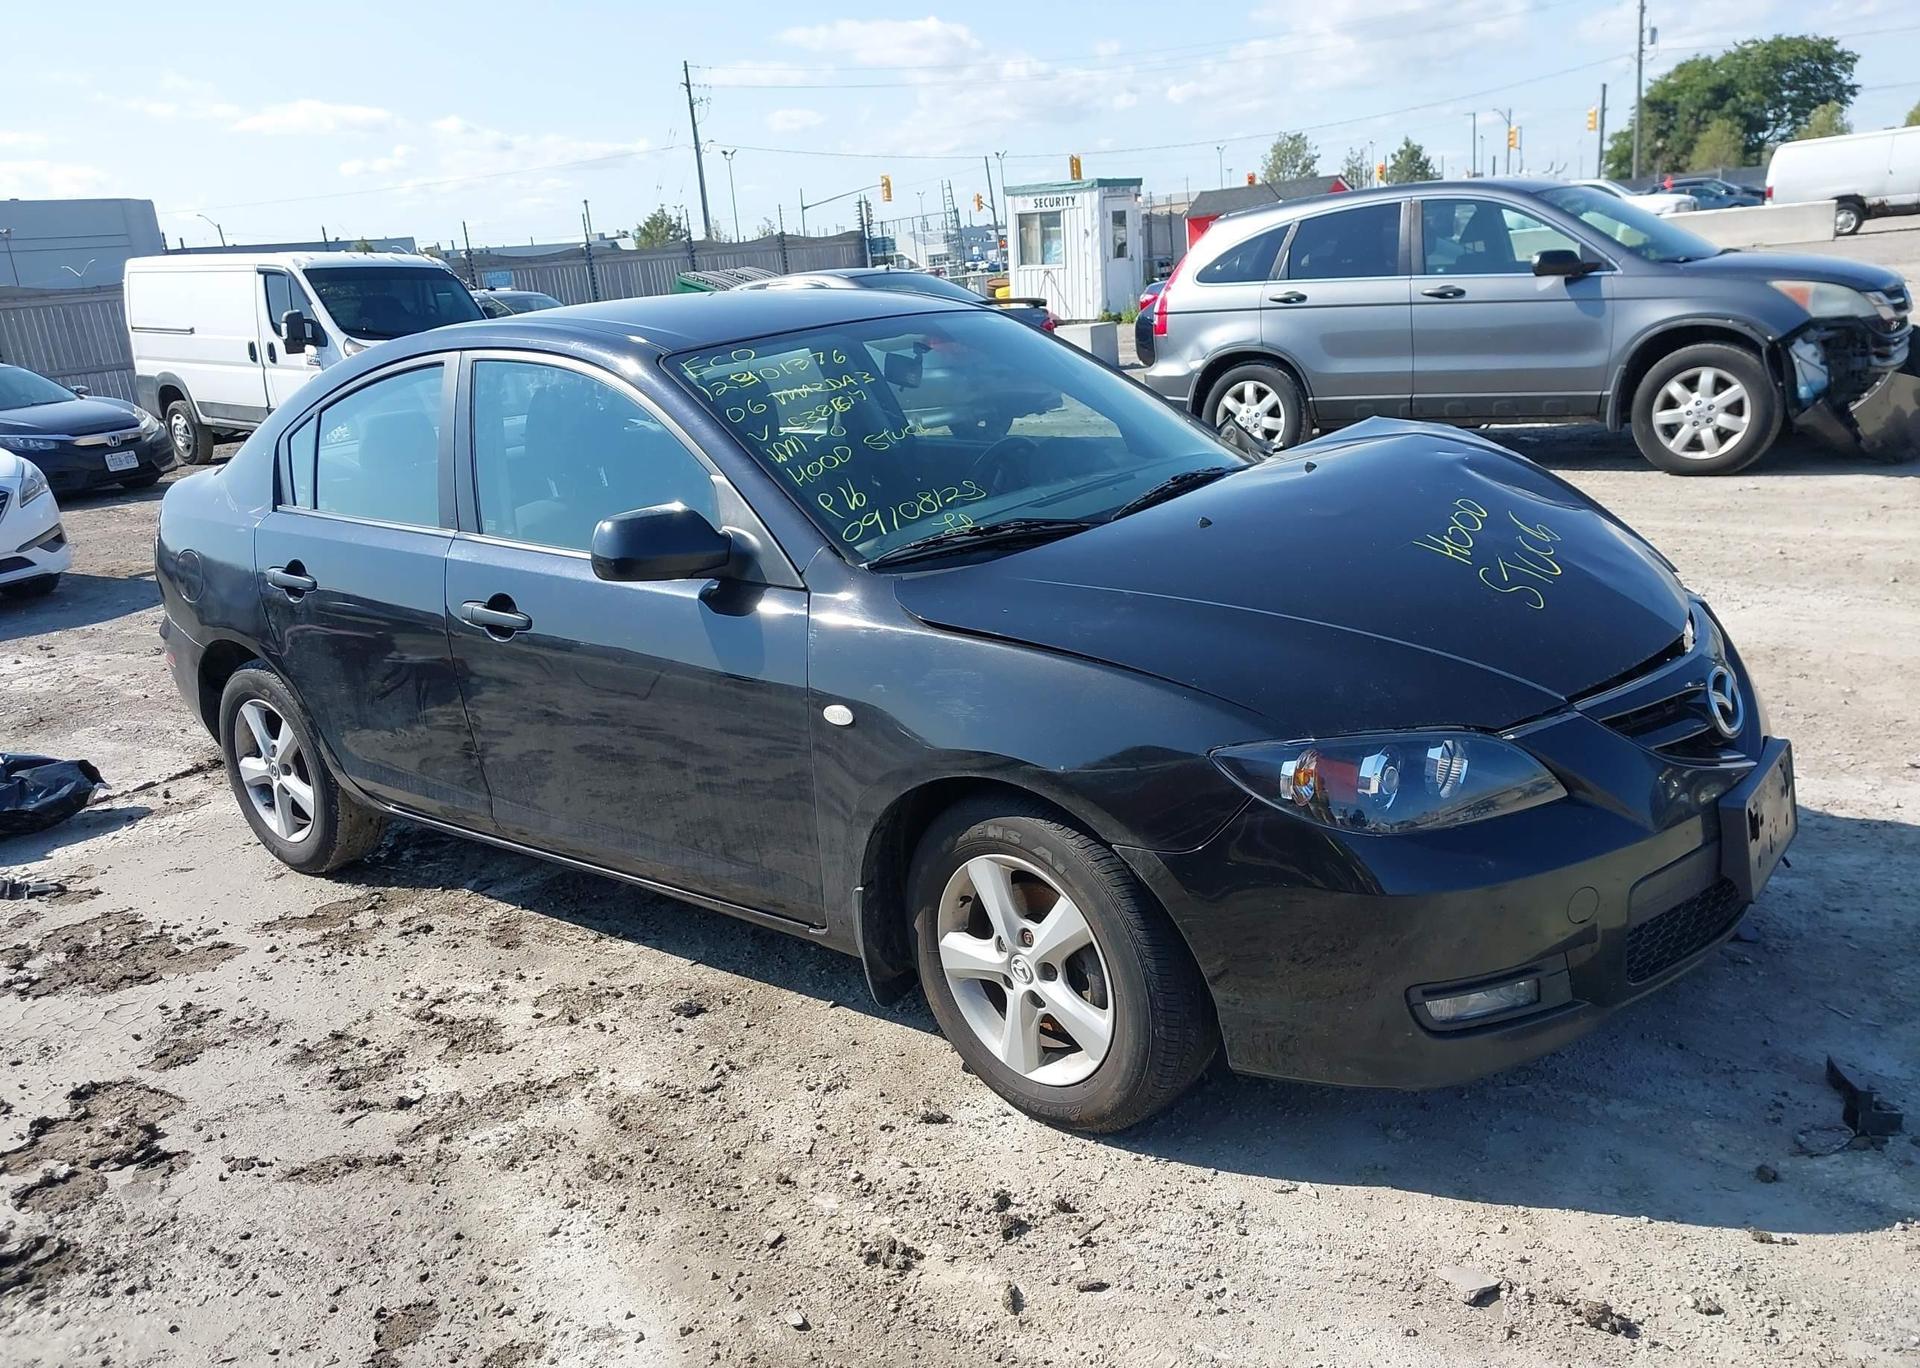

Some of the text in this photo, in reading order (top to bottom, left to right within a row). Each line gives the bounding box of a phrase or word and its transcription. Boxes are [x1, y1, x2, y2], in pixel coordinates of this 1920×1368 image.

[1033, 195, 1076, 209] SECURITY
[680, 348, 756, 379] ECO
[726, 398, 767, 423] 06
[787, 446, 852, 487] HOOD
[1412, 498, 1488, 565] HOOD
